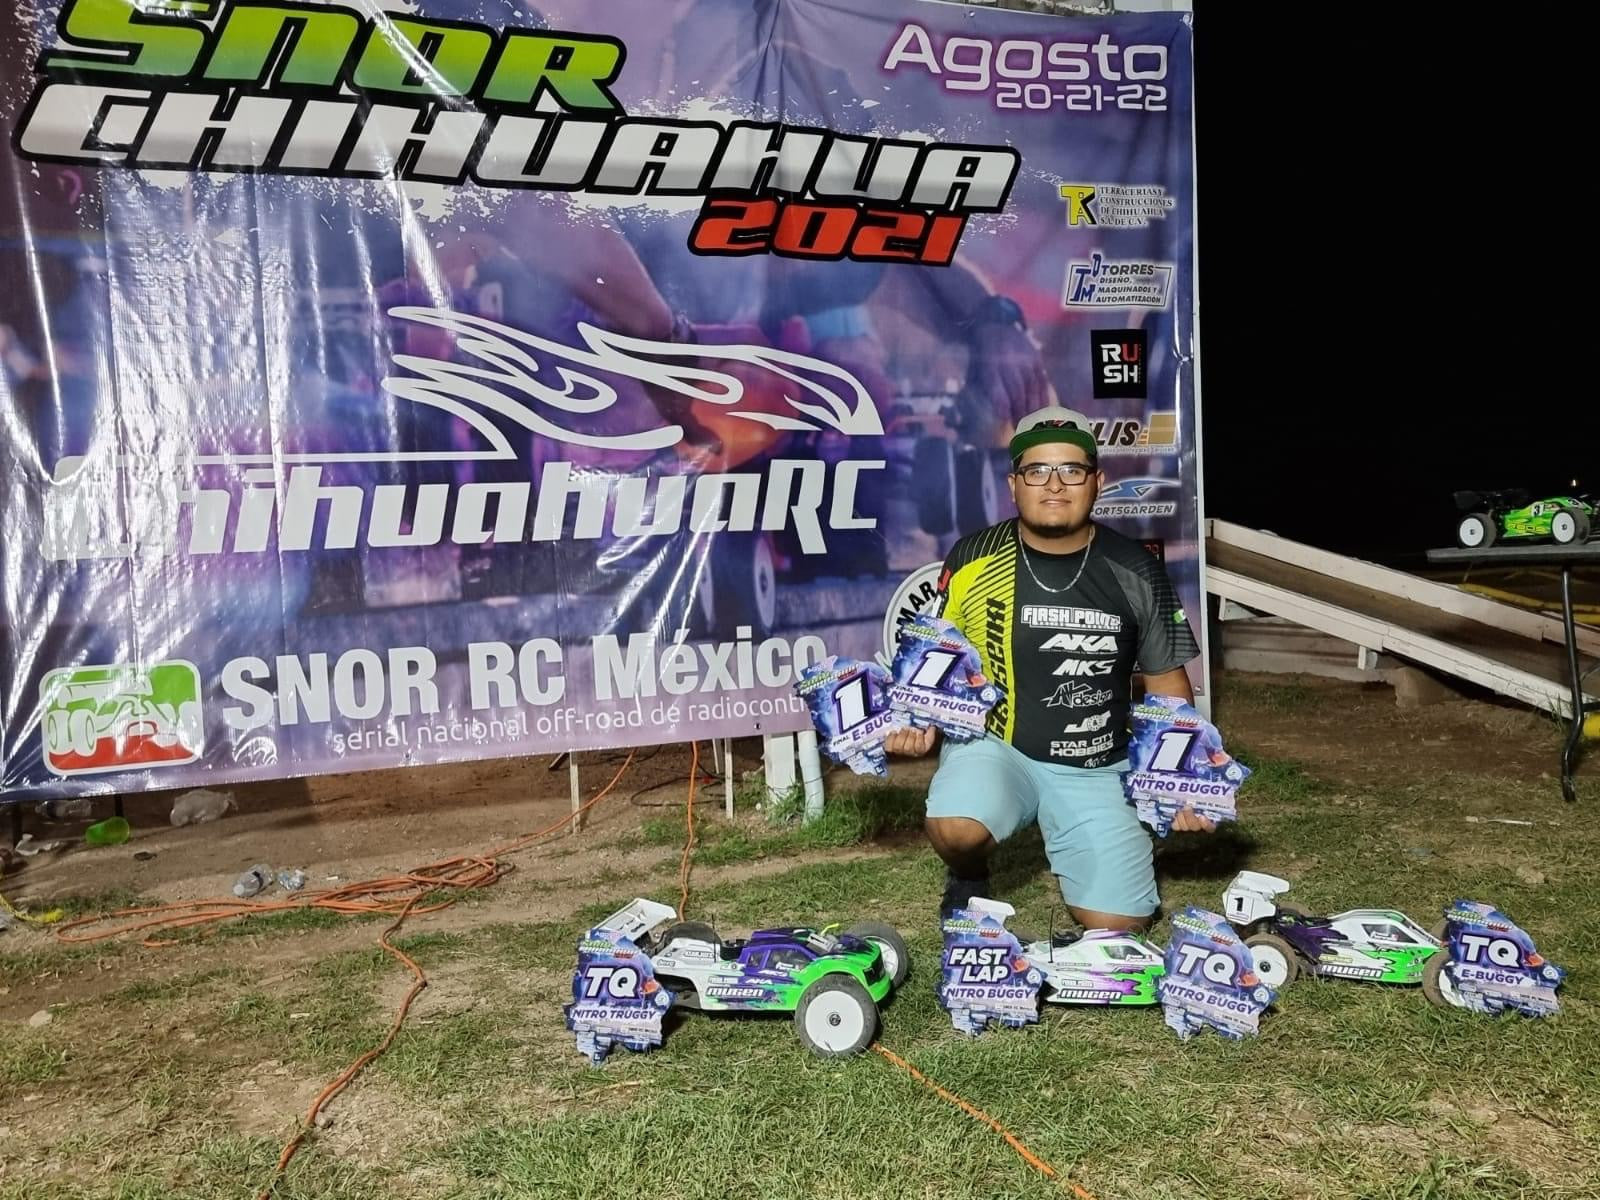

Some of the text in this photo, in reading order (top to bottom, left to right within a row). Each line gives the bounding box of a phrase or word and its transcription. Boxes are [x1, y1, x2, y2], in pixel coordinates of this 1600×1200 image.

[44, 0, 620, 112] SNOR
[884, 23, 1168, 89] Agosto
[995, 82, 1168, 111] 20-21-22
[20, 82, 1018, 209] CHIHUAHUA
[1100, 197, 1173, 207] CONSTRUCCIONES
[1101, 207, 1163, 216] DE CHIHUAHUA
[693, 200, 967, 264] 2021
[1101, 264, 1154, 275] TORRES
[1098, 286, 1151, 294] MAQUINADOS
[1090, 422, 1140, 446] LIS
[1091, 505, 1173, 516] ORTSGARDEN
[1039, 633, 1118, 652] AKA
[912, 651, 957, 689] 1
[1052, 659, 1116, 676] MKS
[222, 645, 440, 730] SNOR
[468, 637, 566, 710] RC
[592, 626, 827, 701] México
[836, 677, 868, 731] 1
[890, 689, 986, 716] NITRO TRUGGY
[333, 720, 407, 752] serial
[417, 710, 529, 744] nacional
[537, 704, 642, 736] off-road
[655, 700, 680, 726] de
[833, 736, 850, 747] FINAL
[1050, 730, 1113, 748] STAR CITY
[1050, 739, 1113, 757] HOBBIES
[1151, 732, 1194, 771] 1
[1131, 778, 1231, 796] NITRO BUGGY
[1235, 897, 1244, 912] 1
[949, 949, 1007, 965] FAST
[1462, 934, 1520, 968] TQ
[962, 966, 1009, 982] LAP
[1179, 944, 1236, 986] TQ
[586, 967, 637, 998] TQ
[1461, 969, 1524, 985] E-BUGGY
[946, 988, 1033, 999] NITRO BUGGY
[1162, 983, 1258, 1014] NITRO BUGGY
[572, 1009, 657, 1020] NITRO TRUGGY
